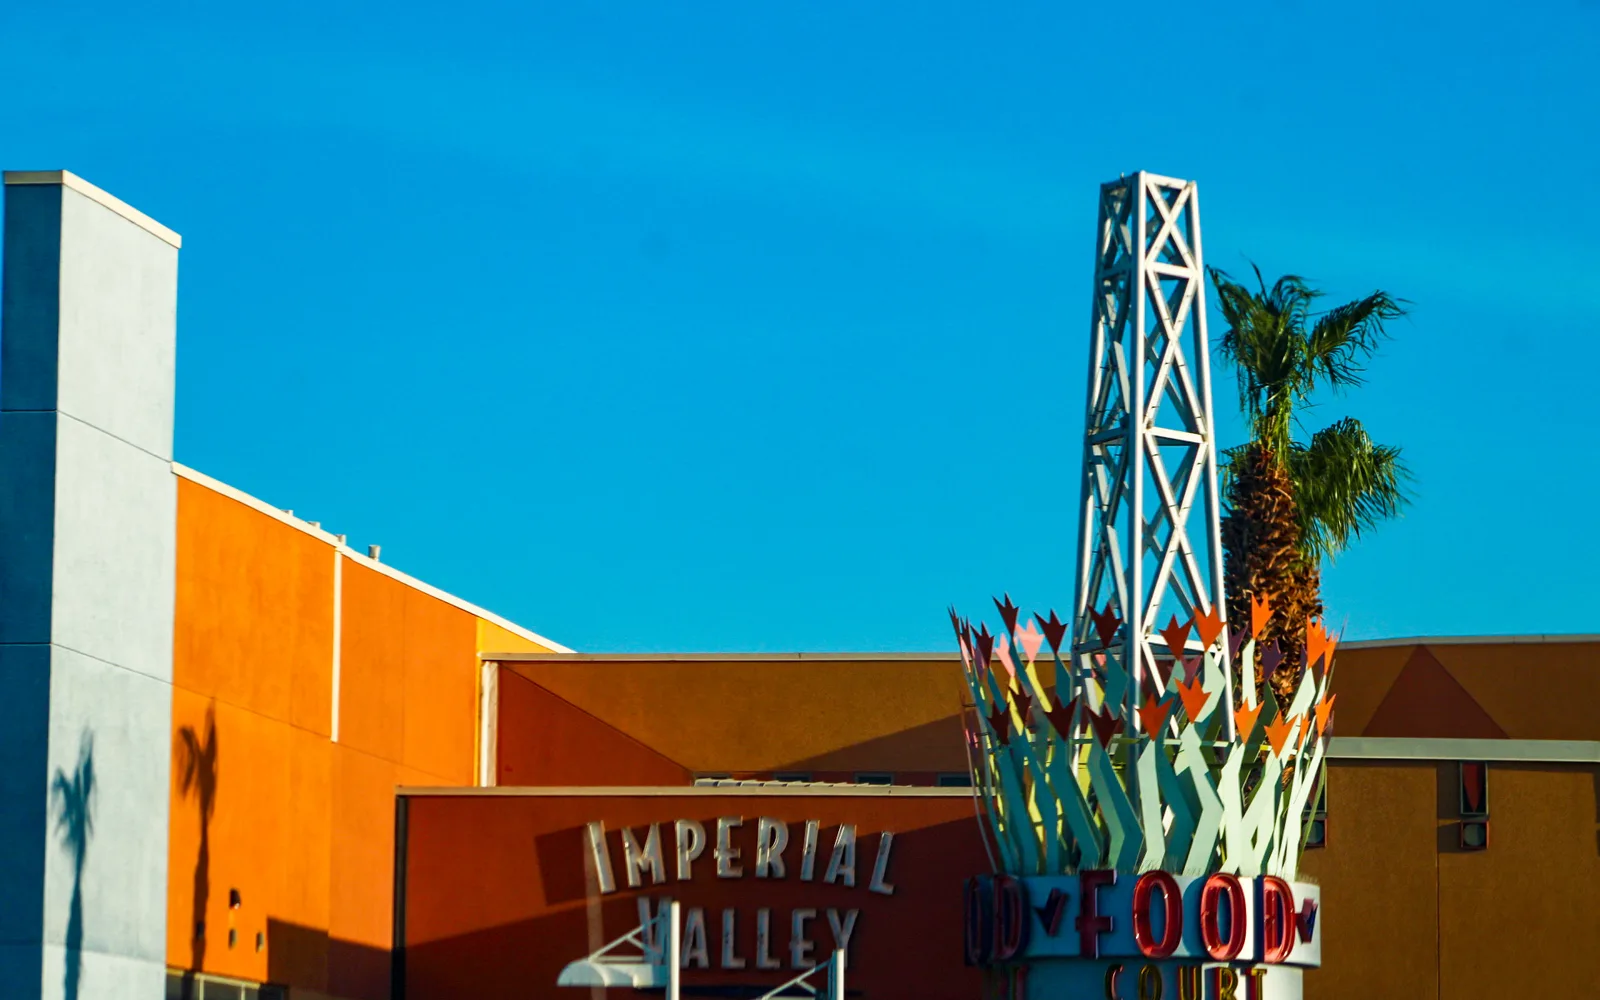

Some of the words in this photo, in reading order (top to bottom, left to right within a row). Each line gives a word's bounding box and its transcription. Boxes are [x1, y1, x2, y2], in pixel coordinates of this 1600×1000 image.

[586, 816, 896, 894] IMPERIAL
[637, 896, 860, 970] VALLEY
[1075, 869, 1297, 963] FOOD
[1104, 963, 1267, 1000] COURT
